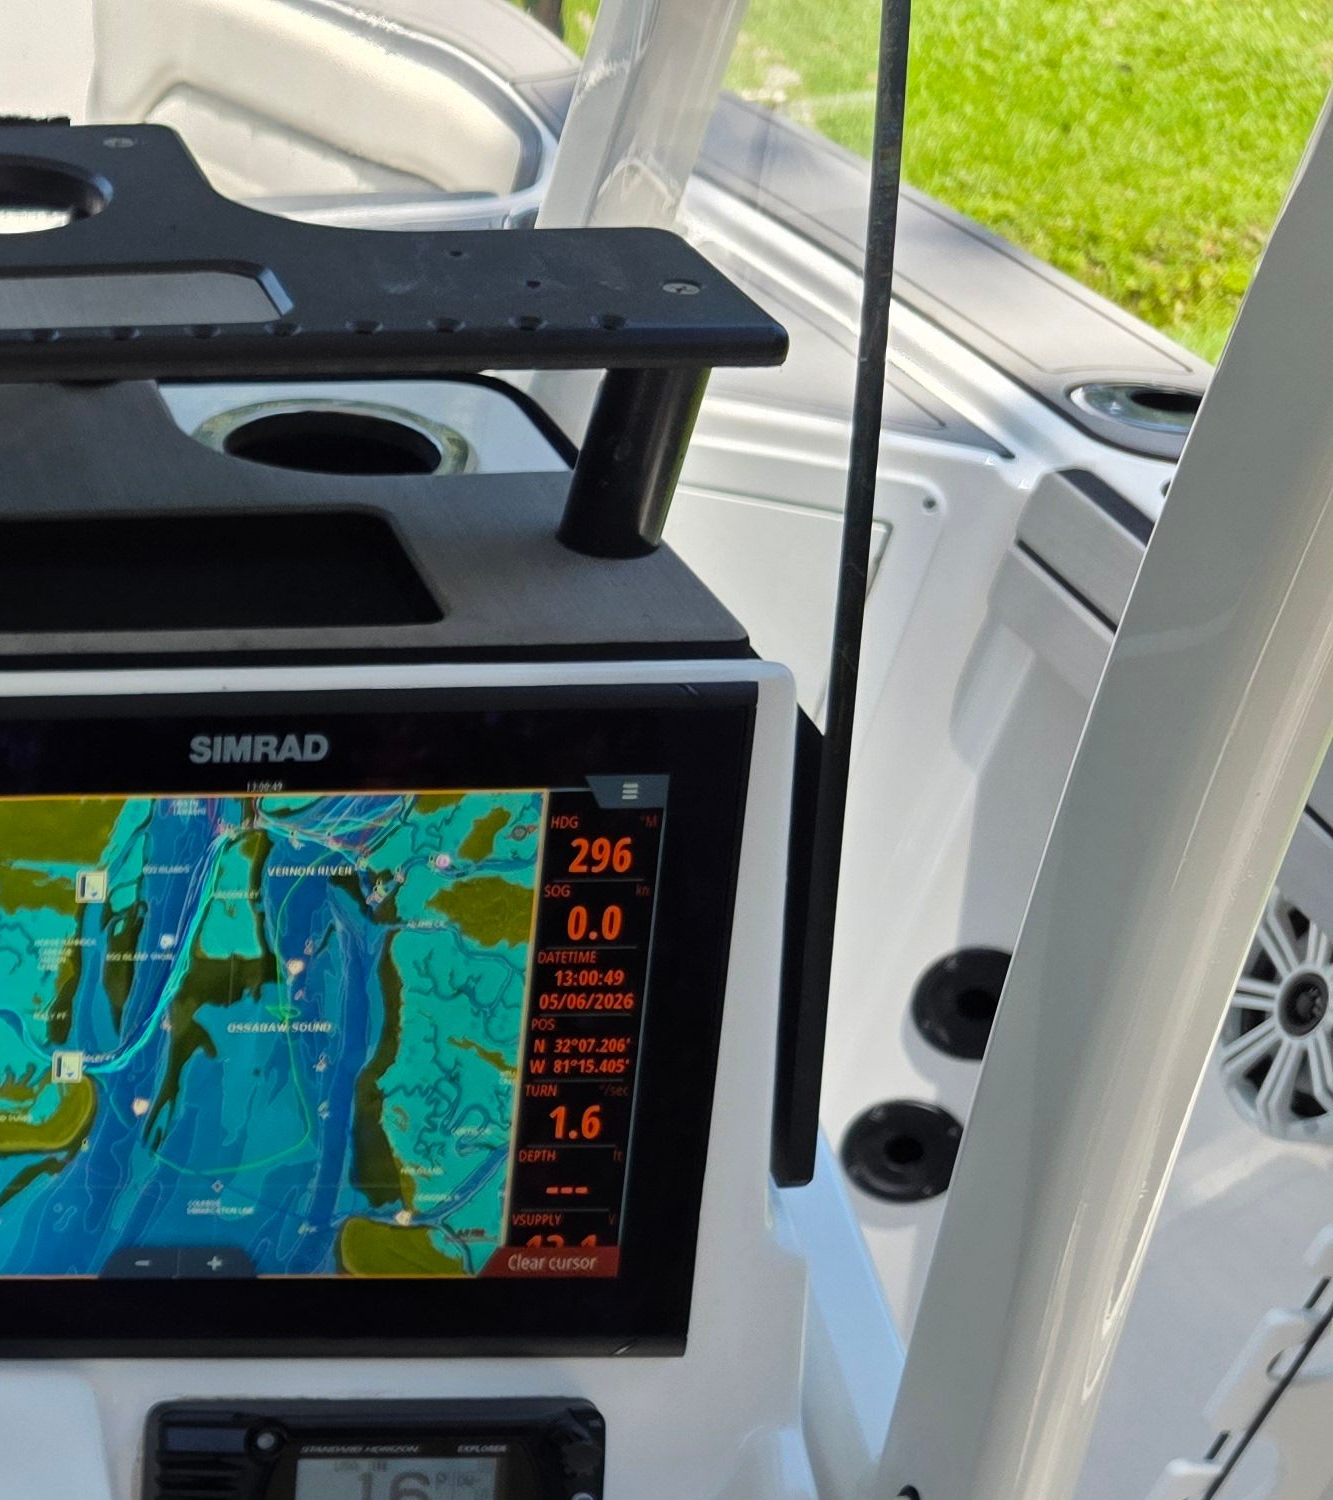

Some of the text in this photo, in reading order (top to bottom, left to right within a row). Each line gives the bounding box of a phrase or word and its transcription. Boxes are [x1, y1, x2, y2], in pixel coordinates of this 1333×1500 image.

[189, 734, 329, 764] SIMRAD
[550, 815, 580, 830] HDG
[567, 836, 633, 874] 296
[267, 865, 353, 877] VERNON RIVER
[544, 884, 571, 898] SOG
[567, 904, 623, 941] 0.0
[537, 951, 597, 965] DATETIME
[555, 970, 625, 987] 13:00:49
[538, 993, 634, 1010] 05/06/2026
[227, 1022, 332, 1033] OSSABAW SOUND
[531, 1018, 556, 1031] POS
[533, 1037, 631, 1053] N 32°07.206'
[529, 1059, 630, 1074] W 81°15.405'
[525, 1084, 558, 1098] TURN
[549, 1104, 602, 1140] 1.6
[518, 1149, 557, 1163] DEPTH
[512, 1214, 562, 1227] VSUPPLY
[508, 1253, 597, 1271] Clear cursor
